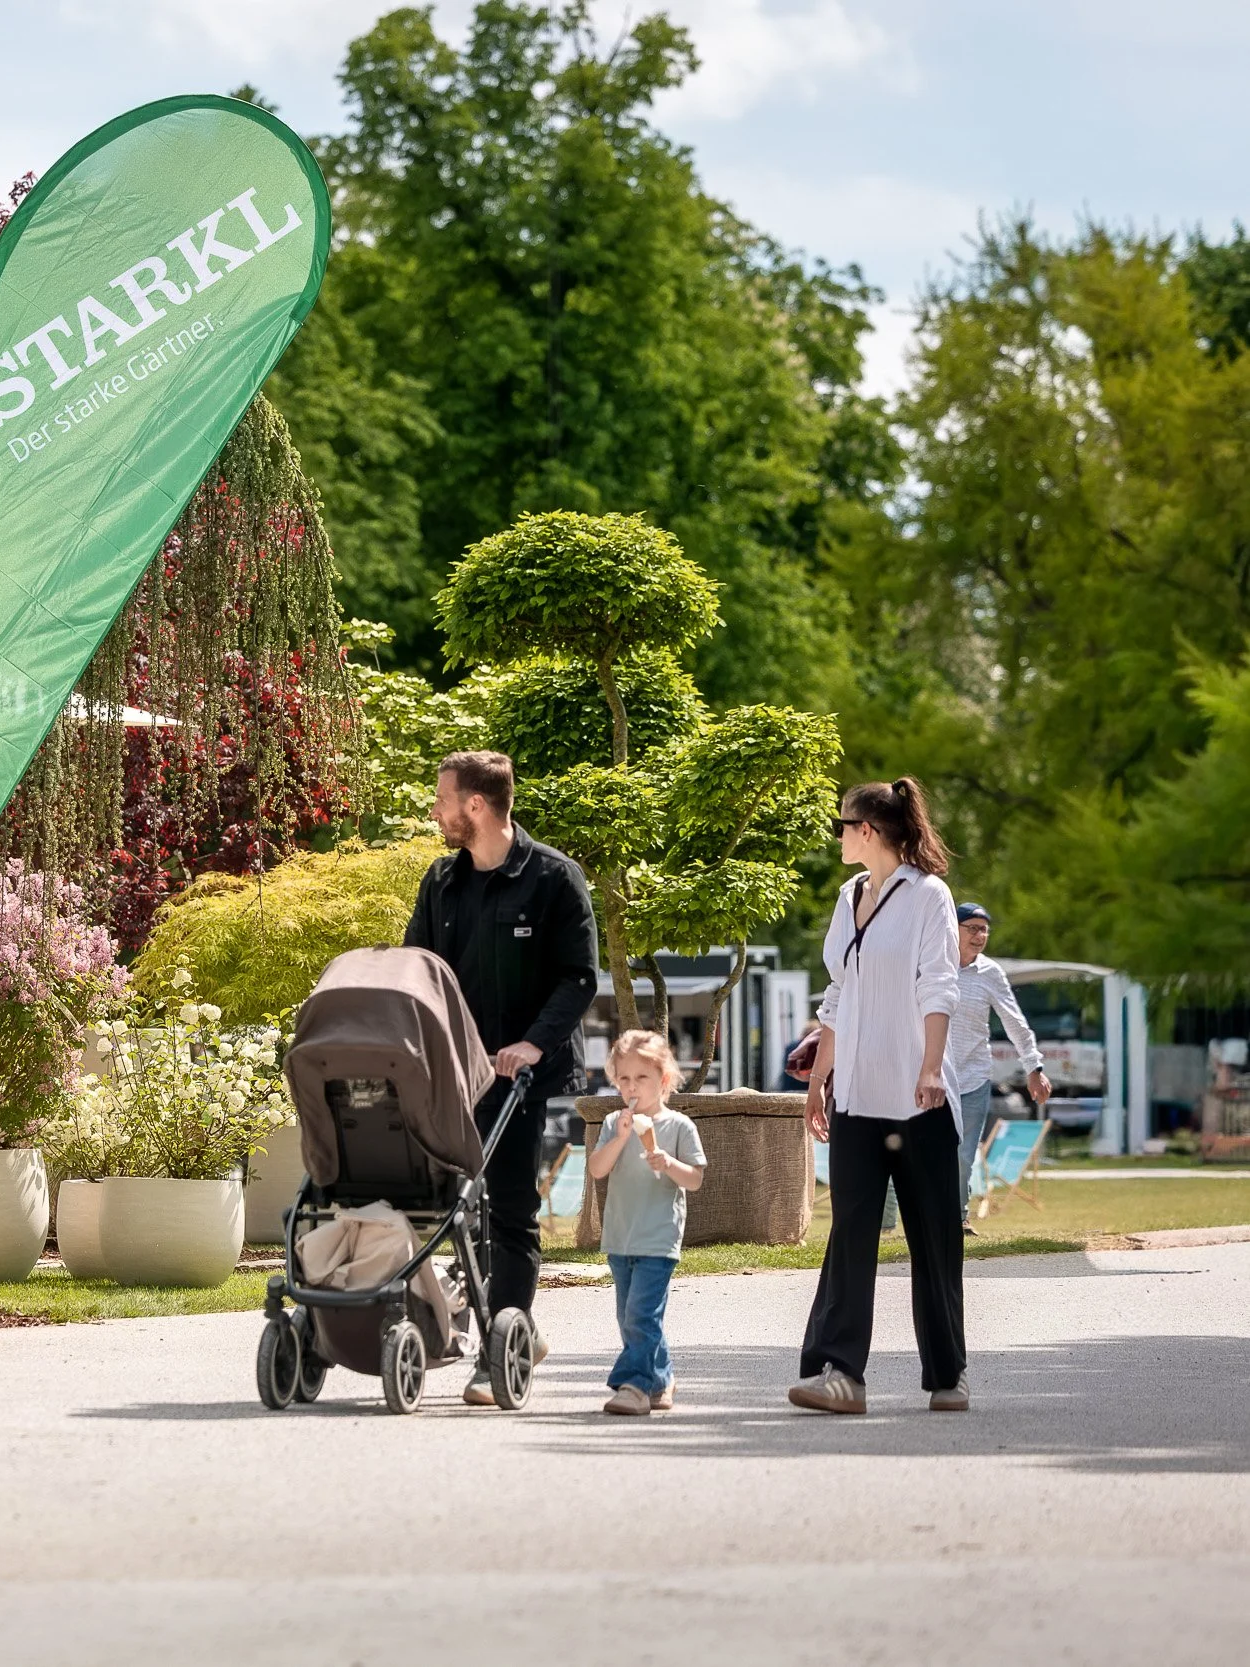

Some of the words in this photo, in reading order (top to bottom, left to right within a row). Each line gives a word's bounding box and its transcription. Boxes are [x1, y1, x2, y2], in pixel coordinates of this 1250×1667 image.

[7, 423, 52, 463] Der
[54, 374, 129, 433] starke
[127, 312, 224, 381] Gärtner.
